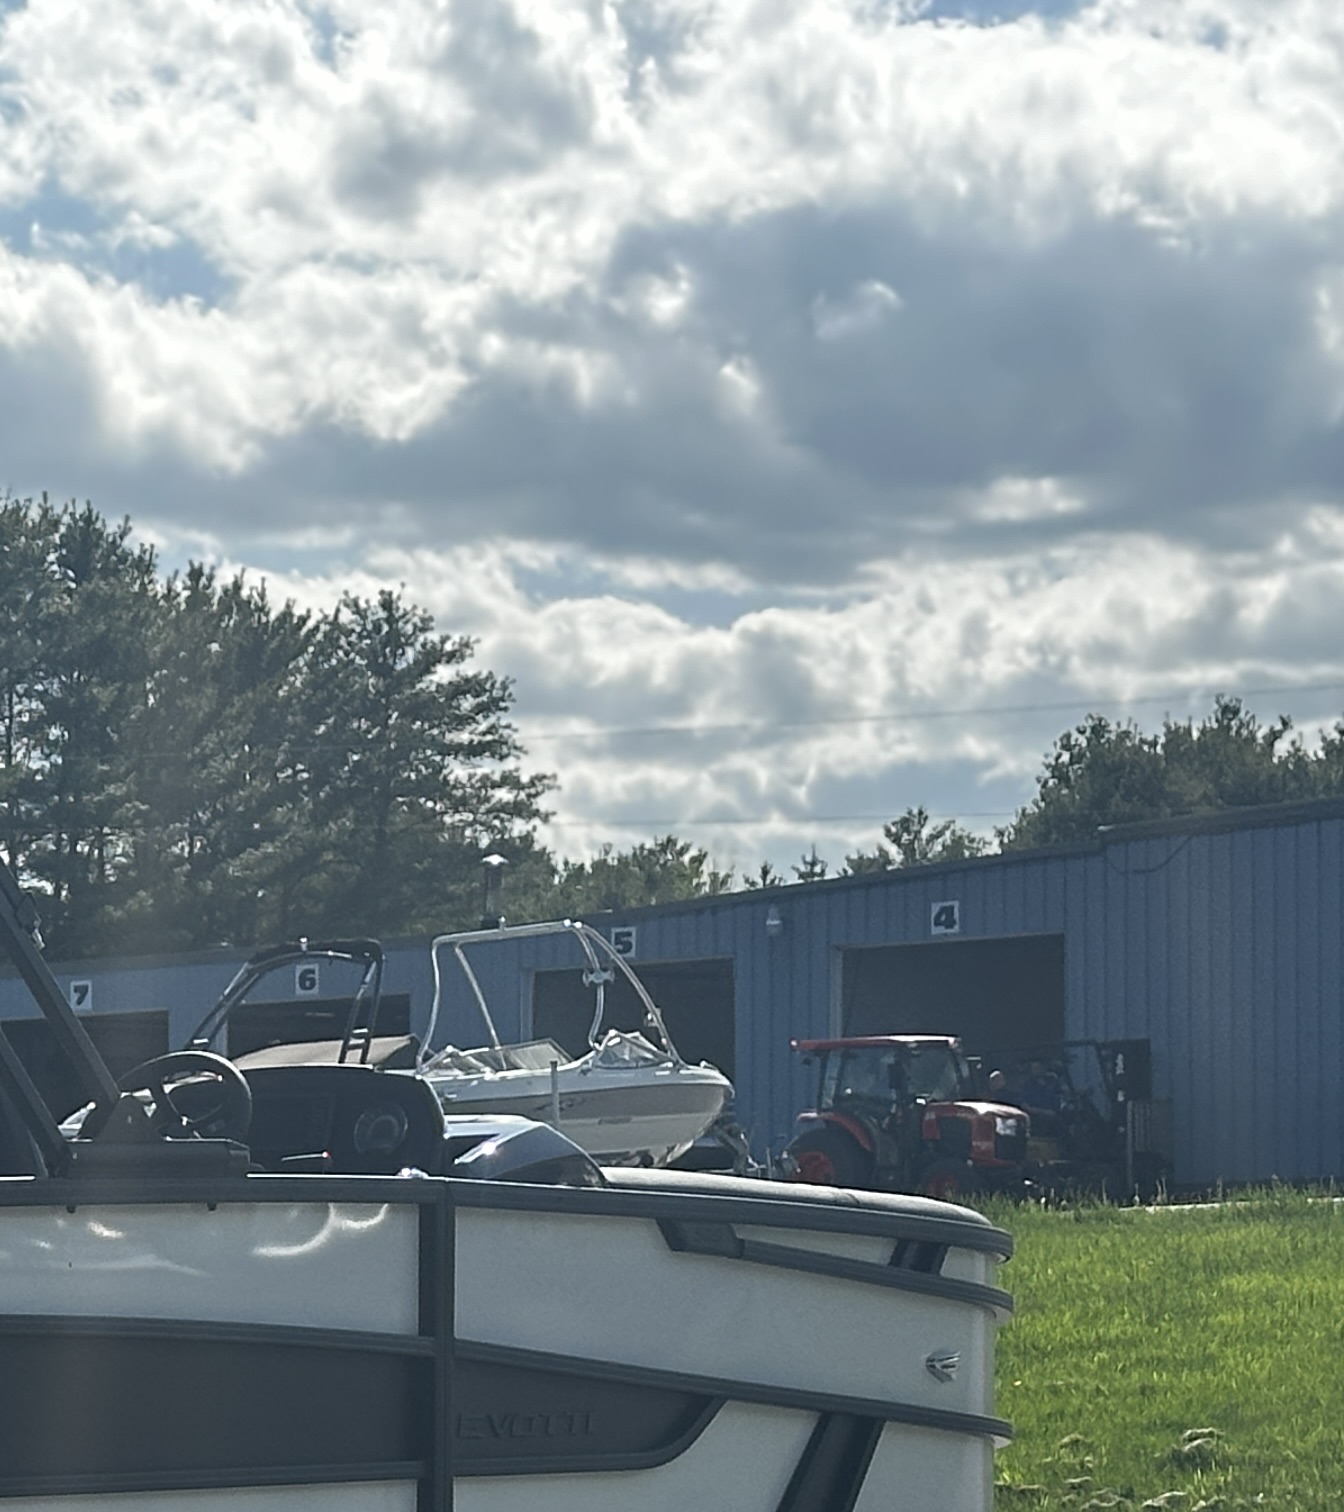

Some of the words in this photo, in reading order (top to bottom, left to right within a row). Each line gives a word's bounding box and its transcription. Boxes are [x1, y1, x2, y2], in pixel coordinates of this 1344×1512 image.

[933, 904, 958, 930] 4
[613, 931, 634, 954] 5
[298, 967, 317, 991] 6
[73, 984, 89, 1006] 7
